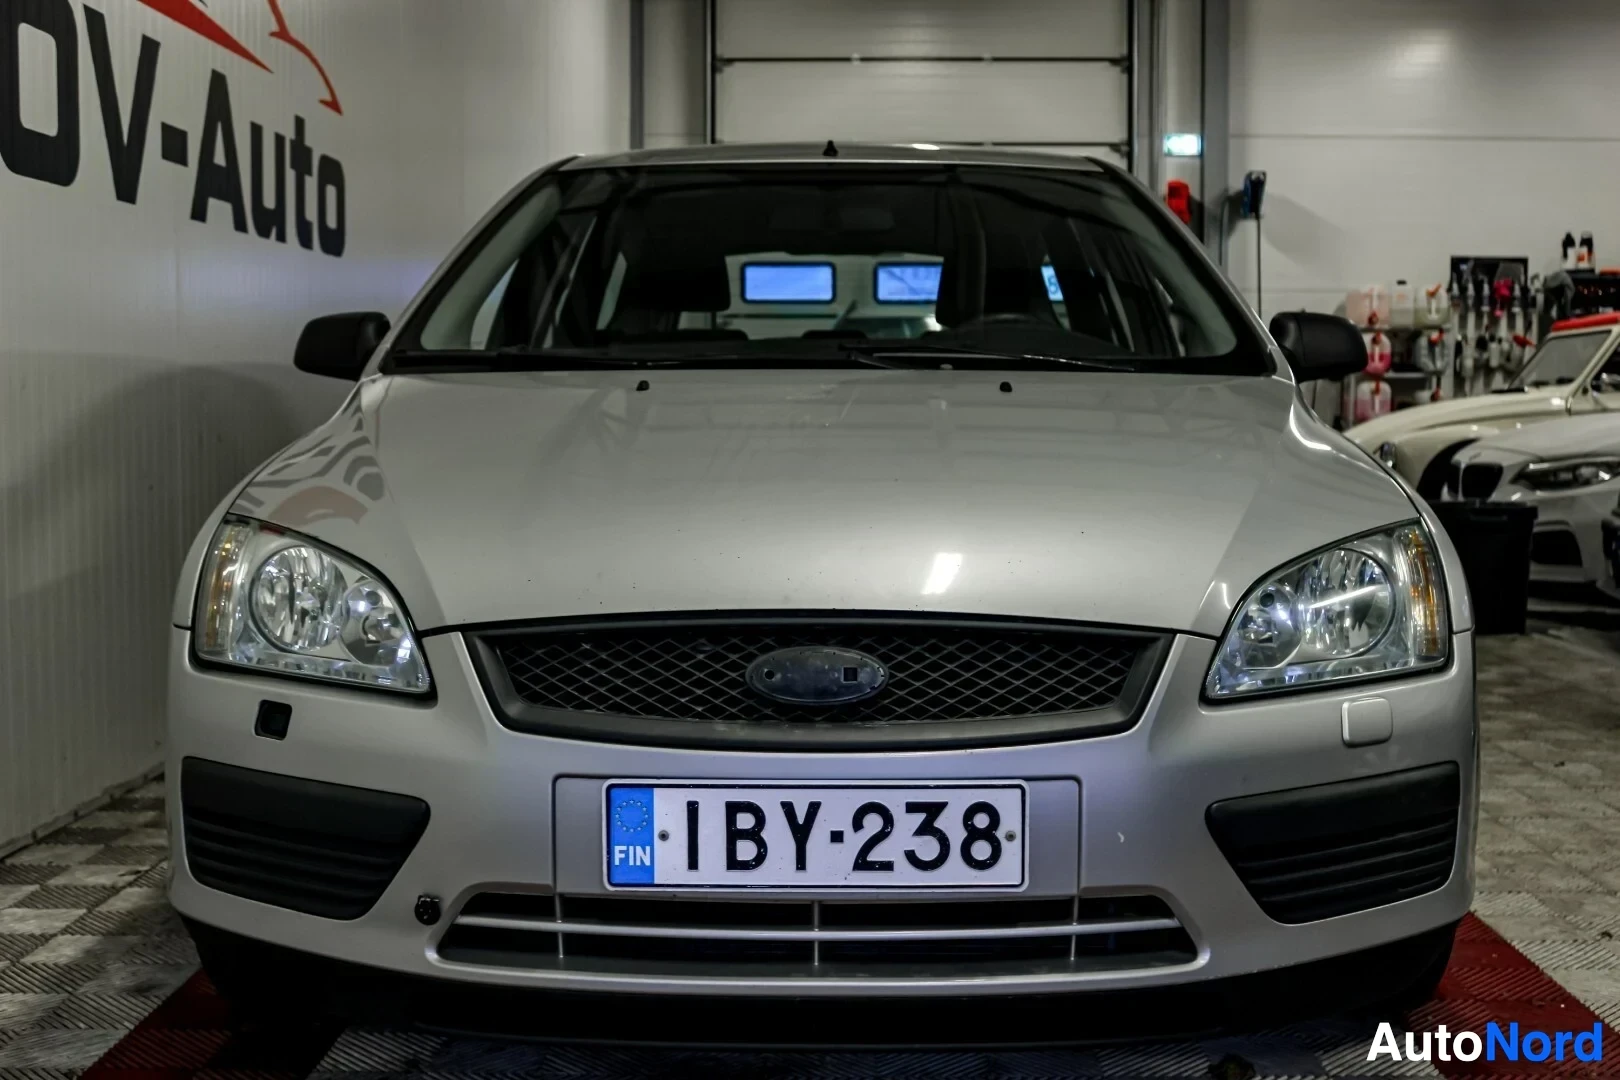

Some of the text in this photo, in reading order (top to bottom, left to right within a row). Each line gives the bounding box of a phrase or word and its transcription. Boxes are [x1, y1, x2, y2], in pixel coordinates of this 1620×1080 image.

[0, 0, 345, 258] OV-Auto
[614, 845, 651, 866] FIN
[687, 800, 1002, 872] IBY-238
